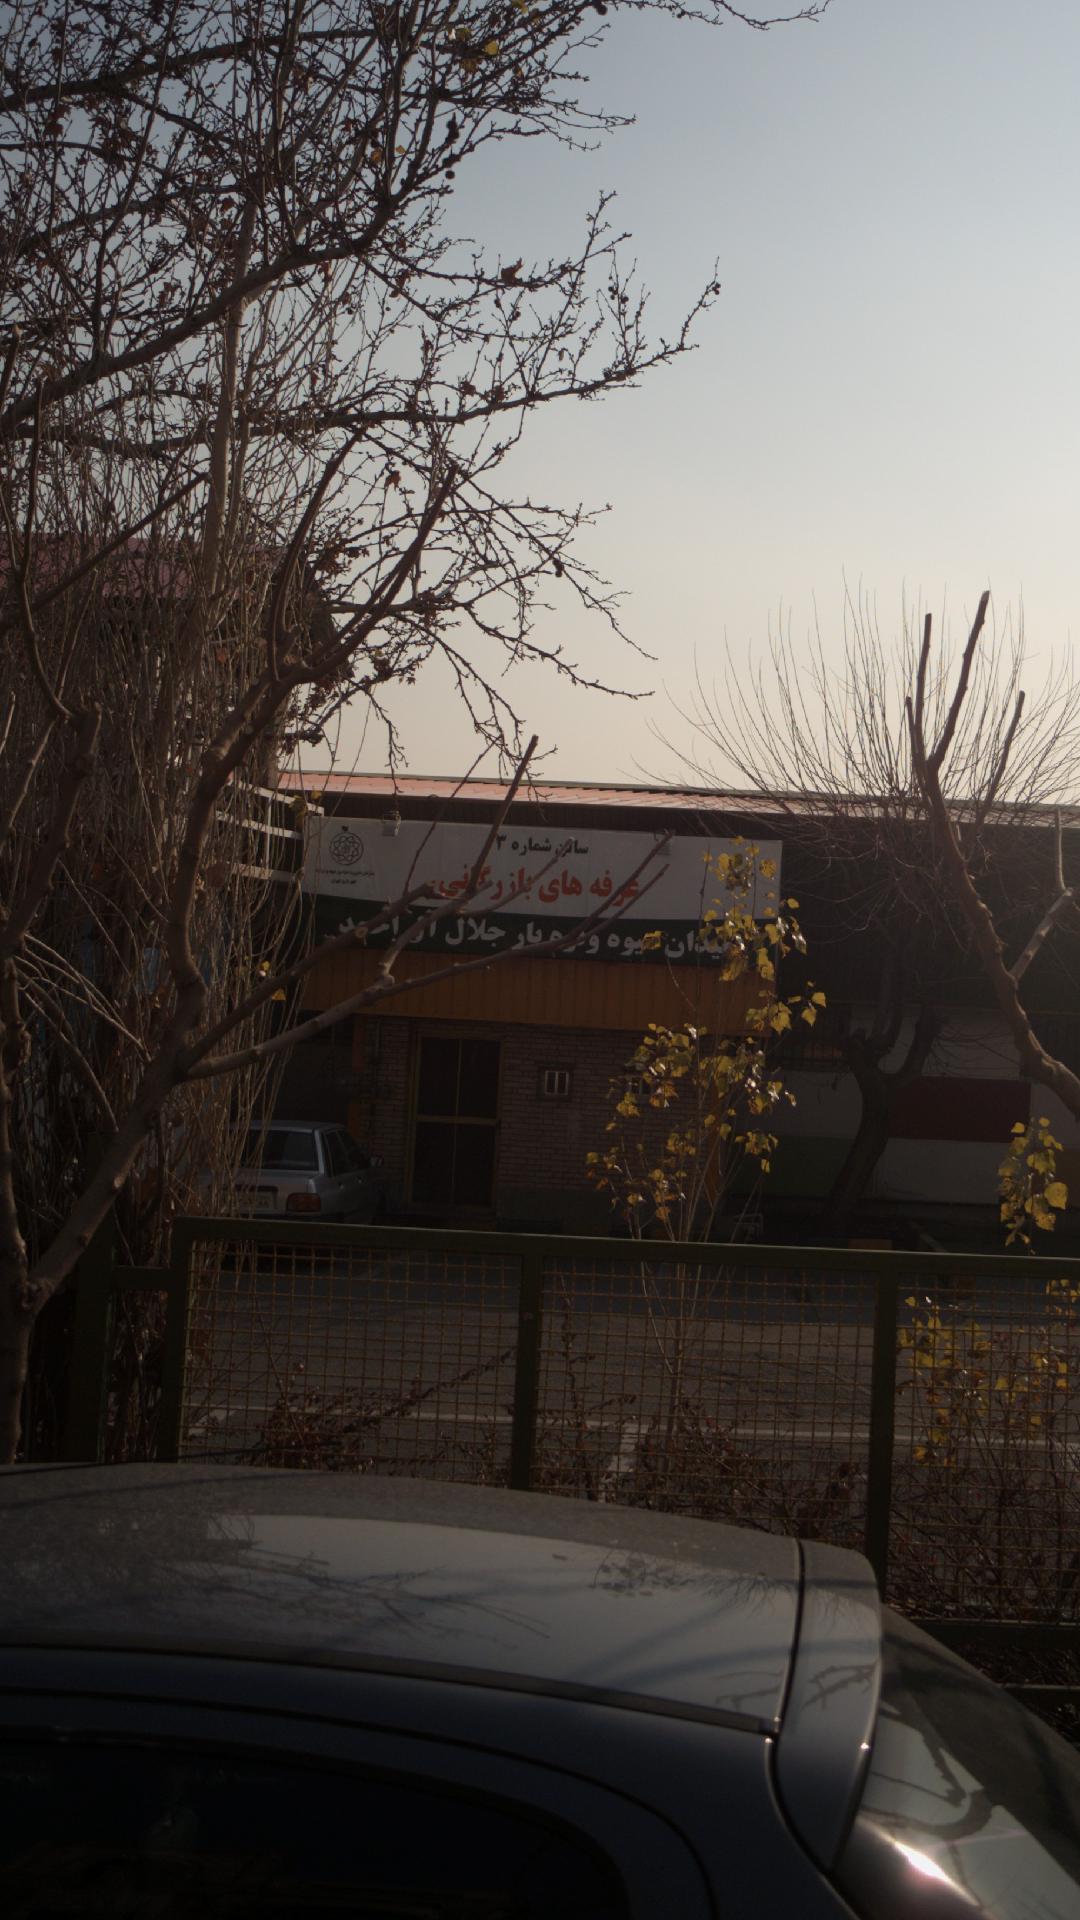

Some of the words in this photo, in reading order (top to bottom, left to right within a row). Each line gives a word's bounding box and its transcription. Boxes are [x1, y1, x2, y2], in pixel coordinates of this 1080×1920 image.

[511, 837, 552, 856] شماره
[538, 869, 583, 903] های
[445, 916, 506, 948] جلال
